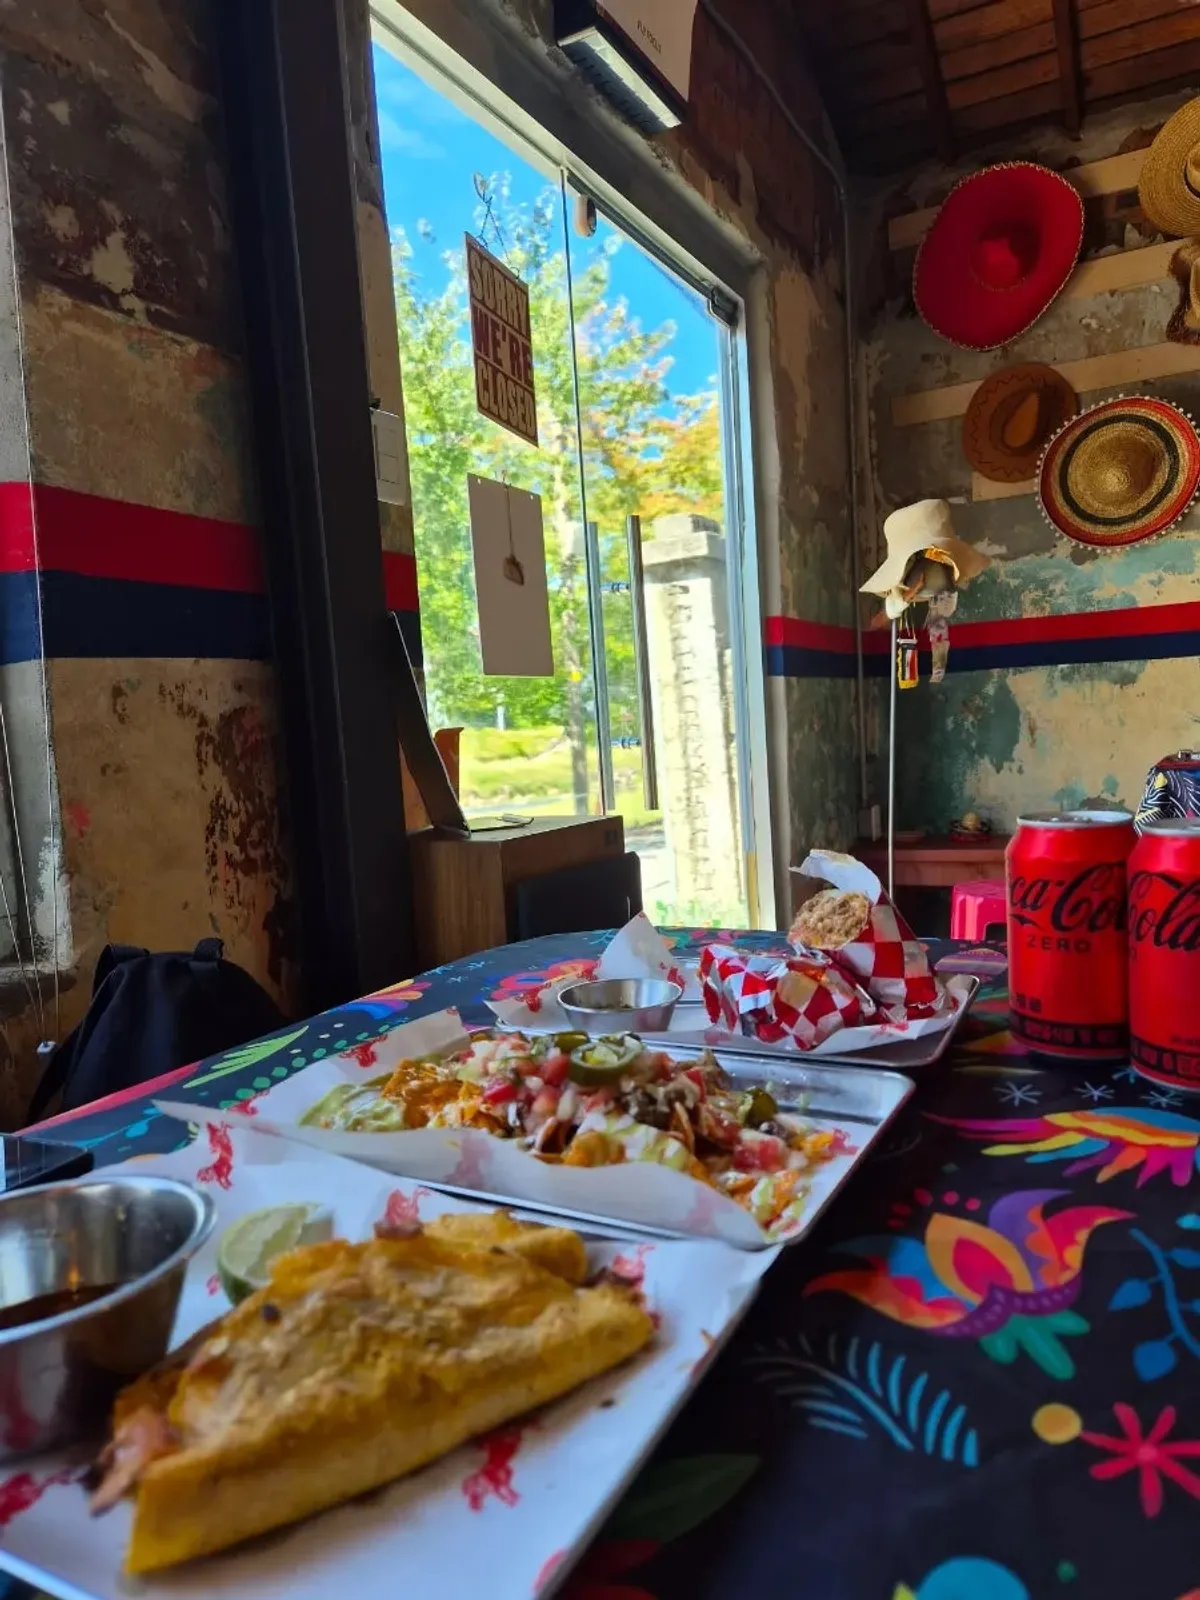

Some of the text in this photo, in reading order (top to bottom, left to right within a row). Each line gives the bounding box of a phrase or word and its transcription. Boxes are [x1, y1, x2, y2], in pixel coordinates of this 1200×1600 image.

[469, 251, 529, 337] SORRY
[473, 305, 533, 388] WE'RE
[478, 361, 536, 437] CLOSED
[1026, 935, 1091, 954] ZERO
